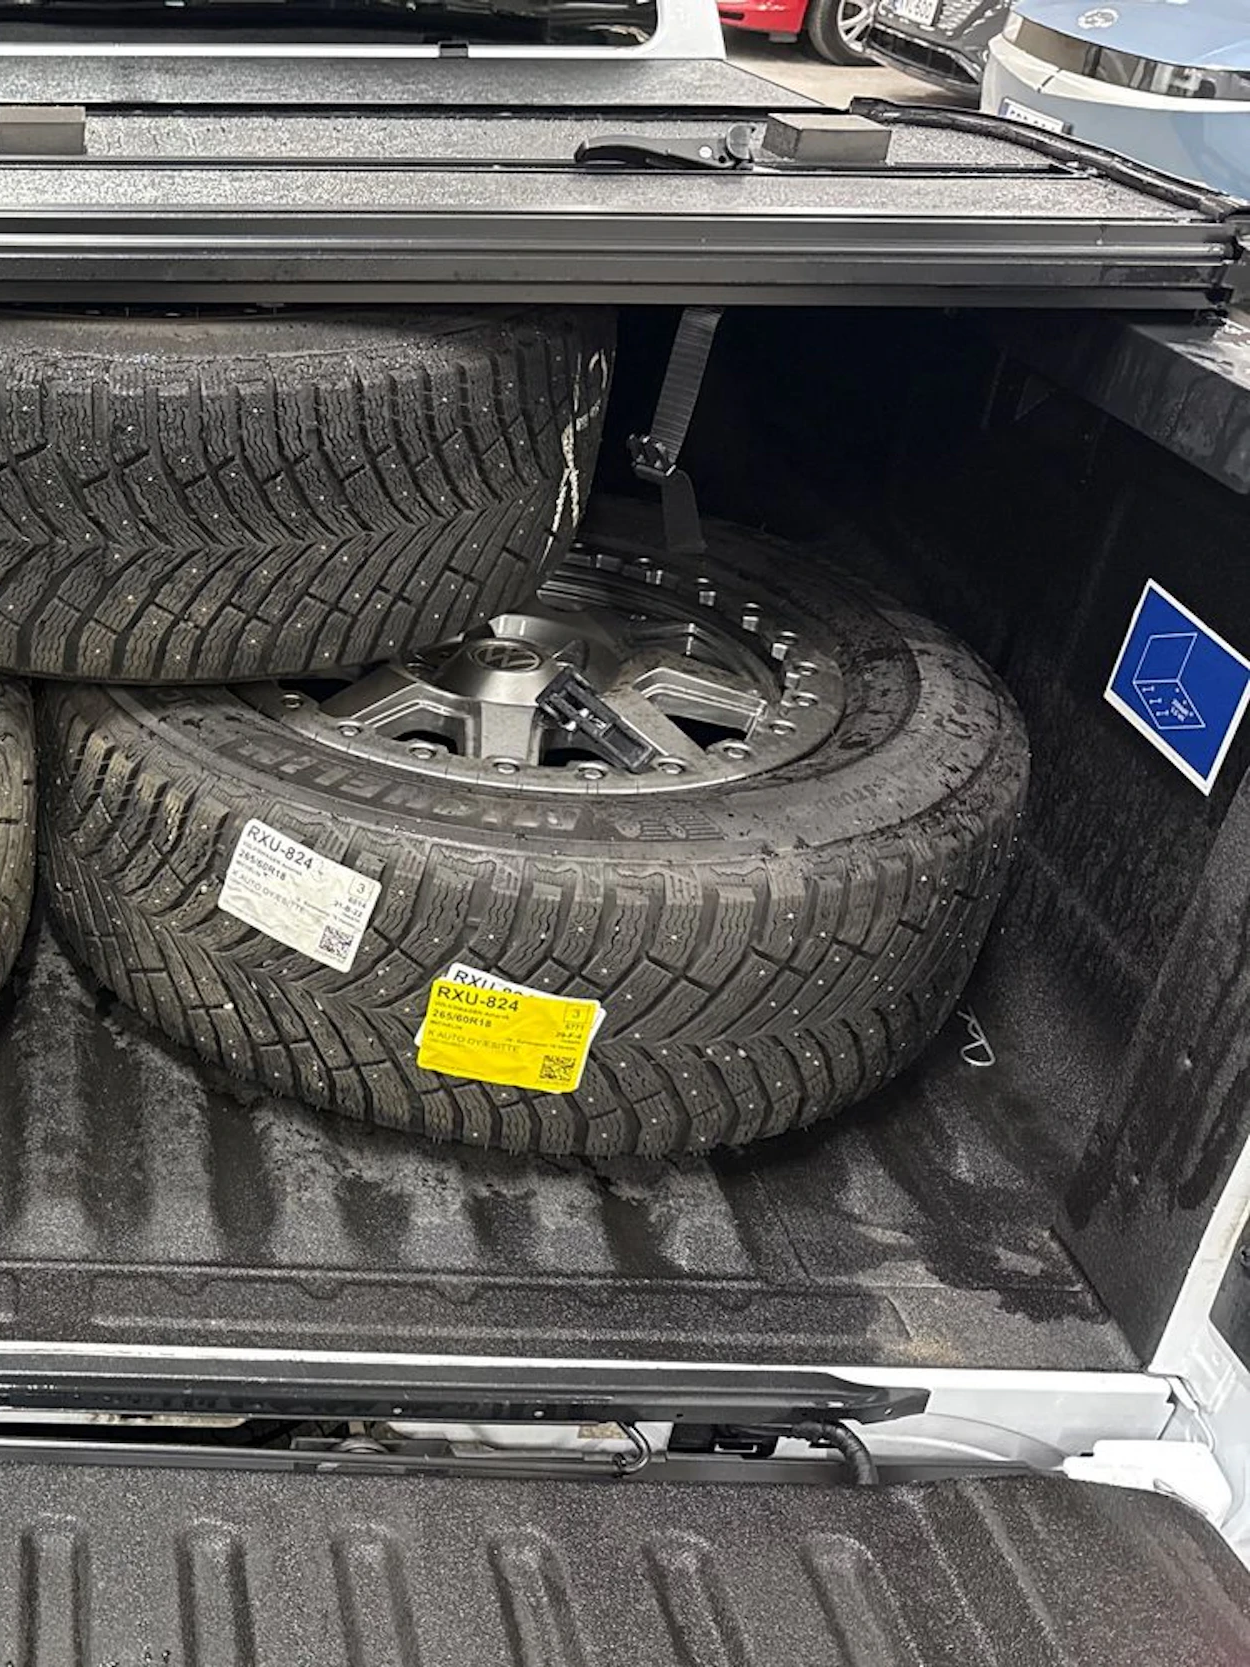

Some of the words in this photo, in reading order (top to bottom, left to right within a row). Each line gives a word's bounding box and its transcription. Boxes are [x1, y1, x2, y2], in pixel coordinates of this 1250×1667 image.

[246, 824, 314, 870] RXU-824
[237, 849, 286, 881] 265/60R18
[356, 883, 365, 895] 3
[436, 985, 519, 1012] RXU-824
[432, 1009, 493, 1028] 265/60R18
